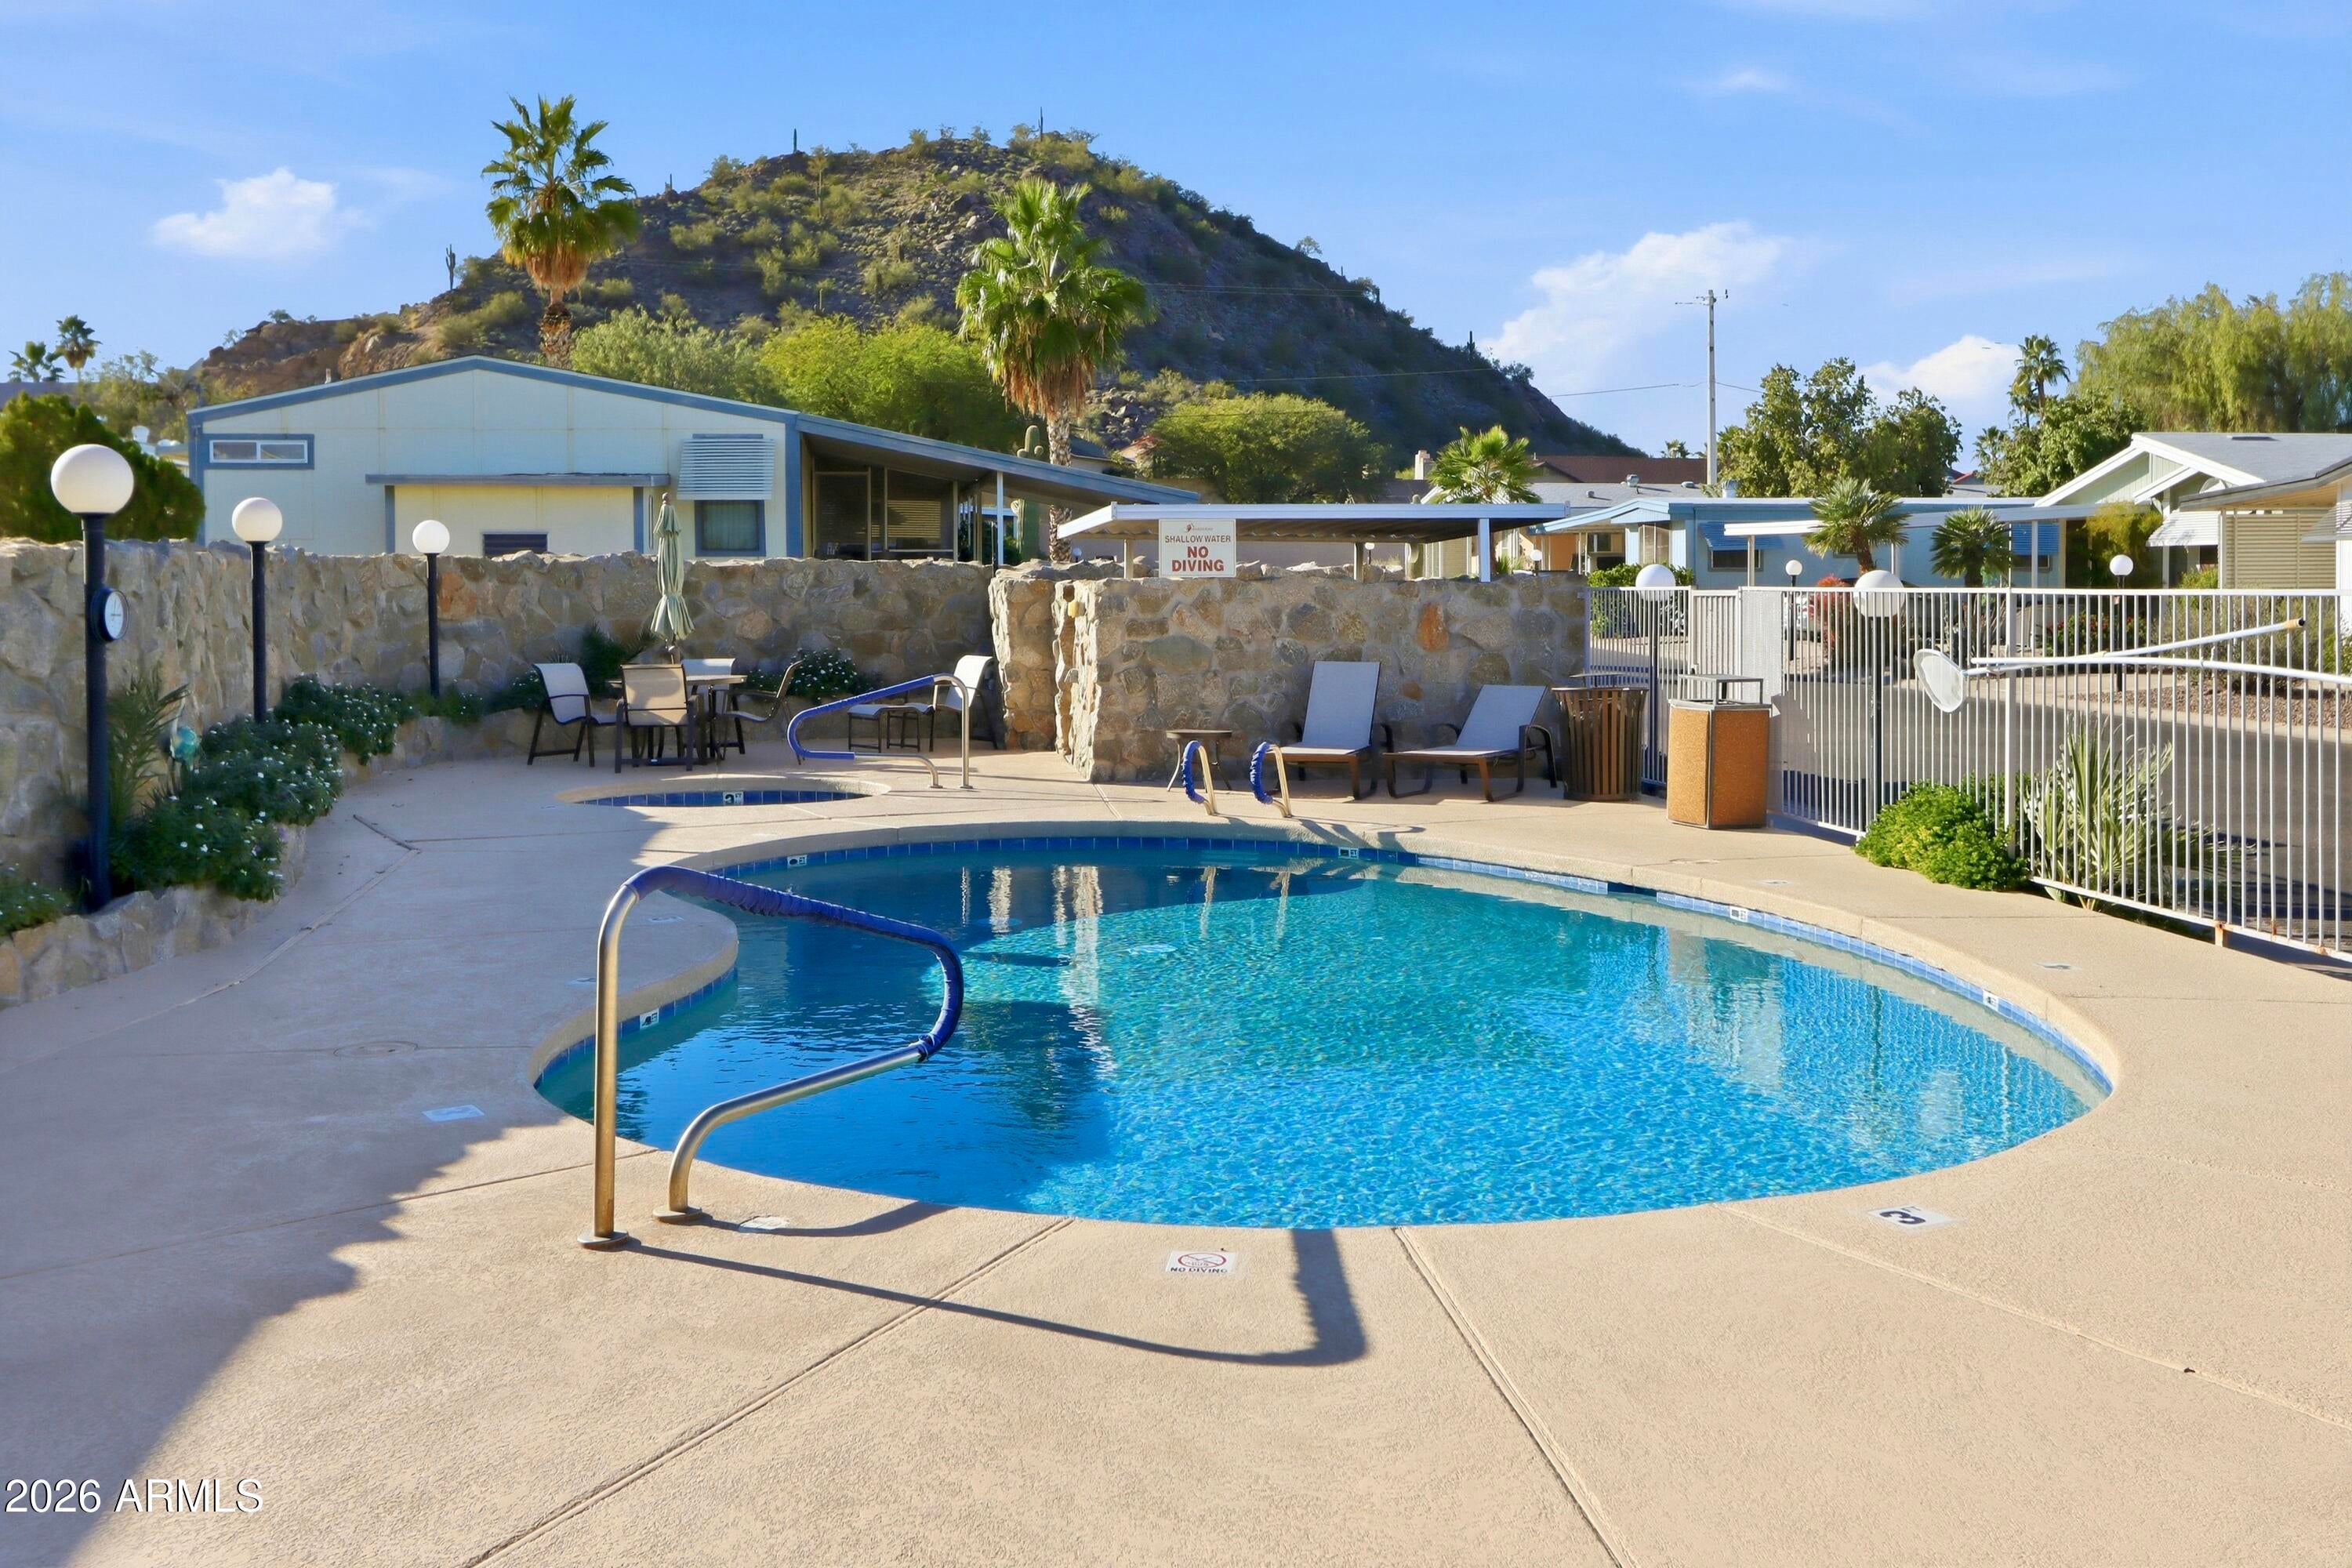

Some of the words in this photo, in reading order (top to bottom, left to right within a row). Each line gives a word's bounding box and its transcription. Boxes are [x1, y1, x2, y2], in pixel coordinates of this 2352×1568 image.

[1187, 546, 1208, 558] NO
[1172, 560, 1224, 572] DIVING
[1879, 1210, 1926, 1225] 3
